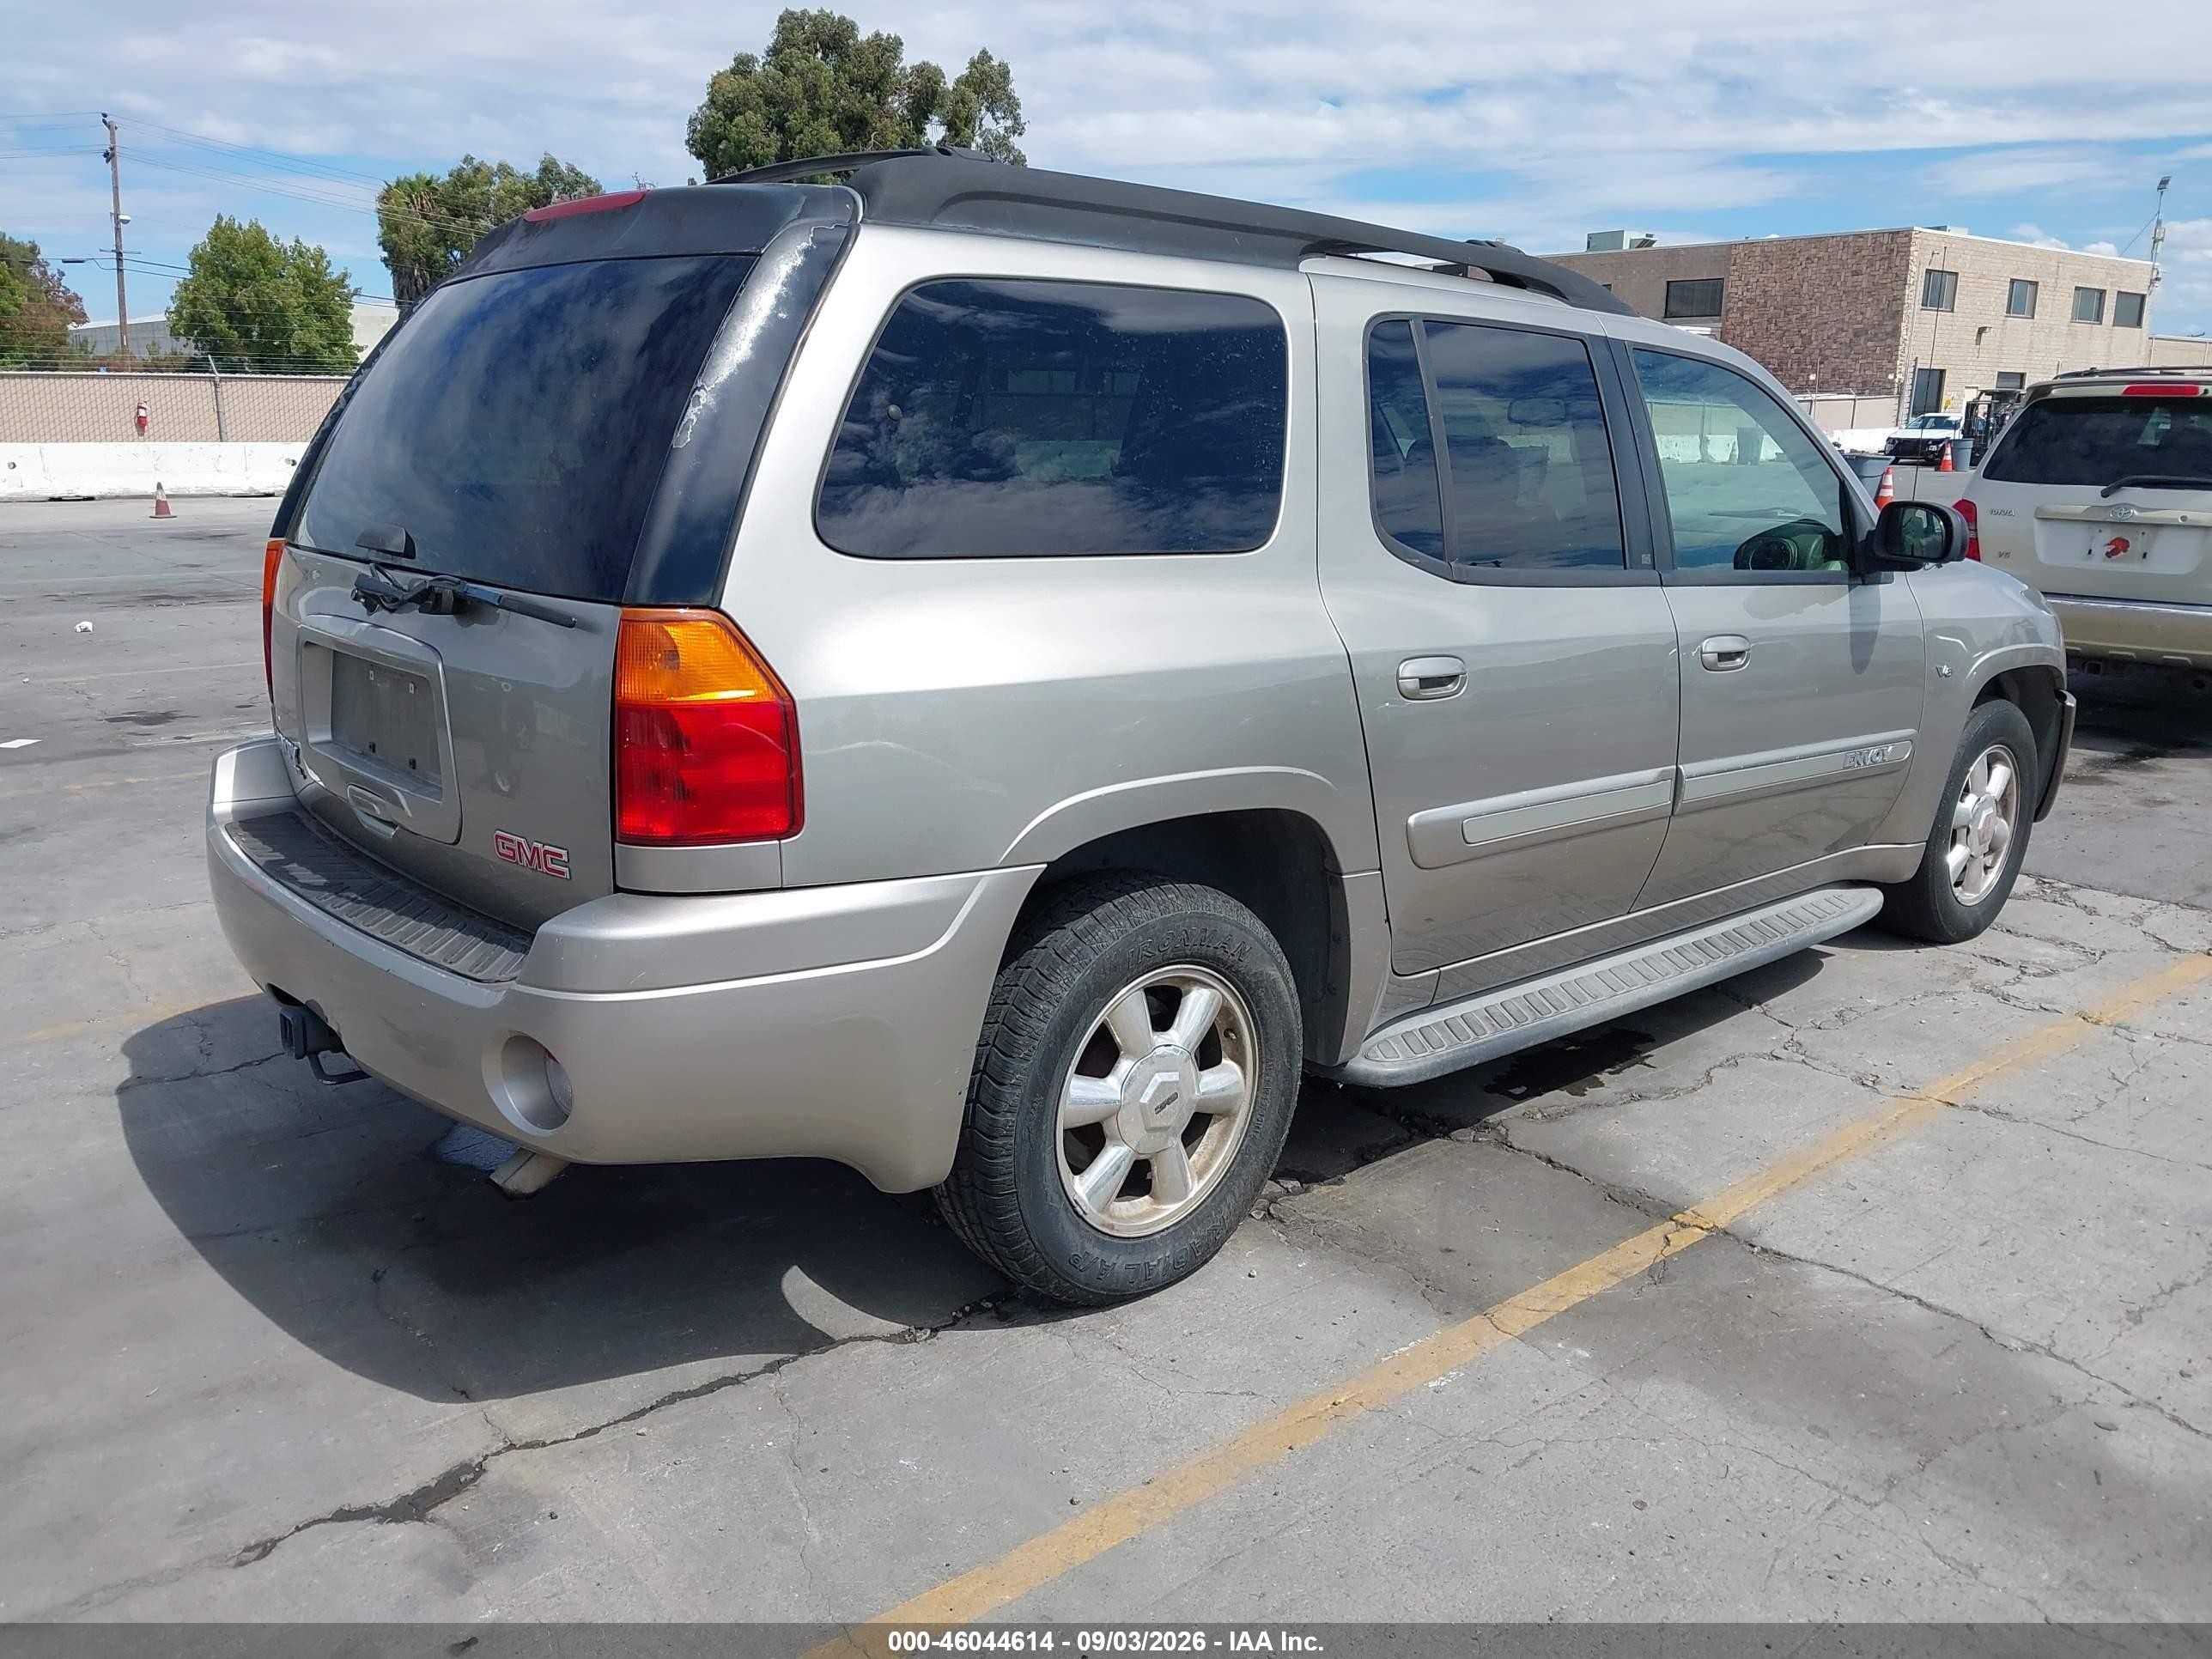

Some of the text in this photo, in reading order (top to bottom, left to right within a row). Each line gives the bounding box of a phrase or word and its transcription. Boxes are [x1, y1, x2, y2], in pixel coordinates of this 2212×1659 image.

[1987, 507, 2015, 517] TOYOTA
[493, 829, 572, 880] GMC
[1127, 927, 1253, 970] IRONMAN
[1067, 1208, 1226, 1285] RADIAL A/P
